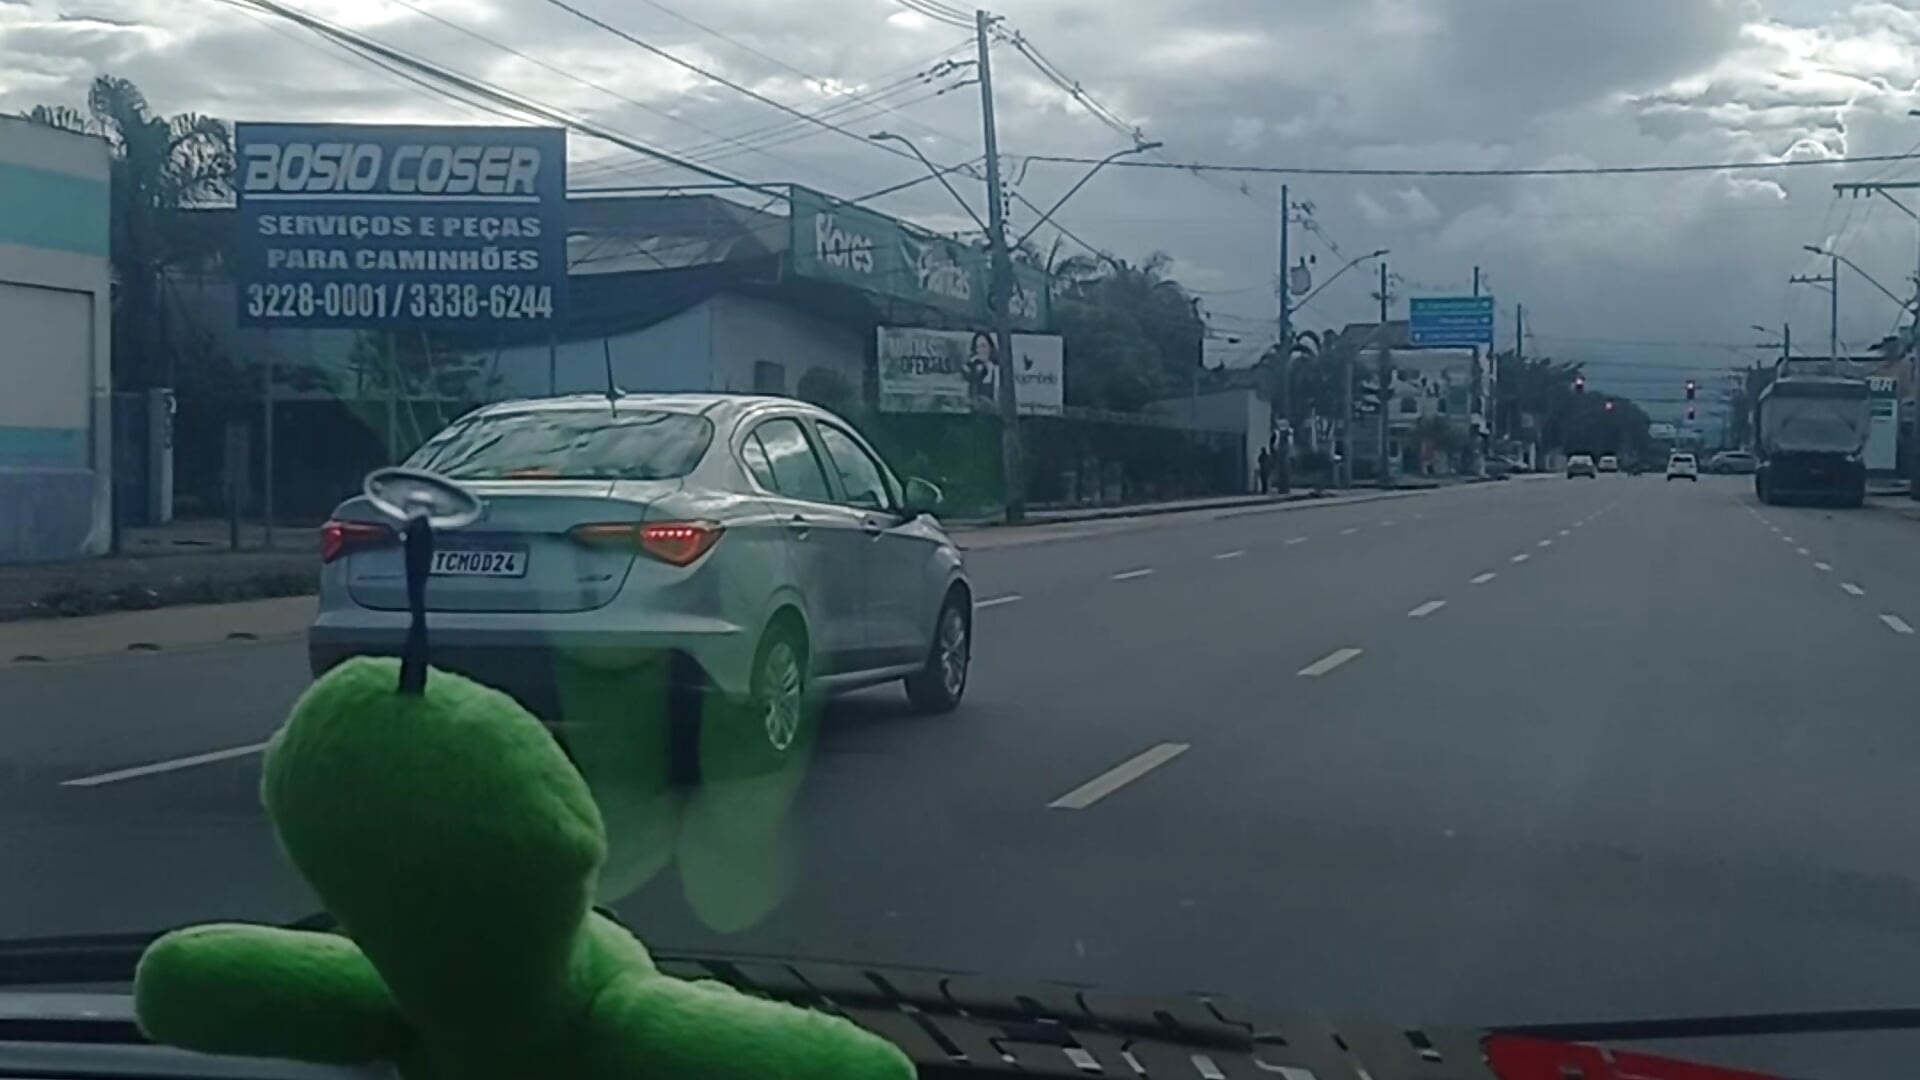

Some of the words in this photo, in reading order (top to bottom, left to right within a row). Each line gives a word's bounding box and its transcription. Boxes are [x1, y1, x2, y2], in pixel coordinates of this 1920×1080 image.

[243, 143, 382, 191] BOSIO
[388, 144, 541, 194] COSER
[258, 215, 412, 240] SERVIÇOS
[420, 217, 436, 237] E
[443, 216, 541, 241] PEÇAS
[267, 248, 348, 270] PARA
[355, 246, 539, 271] CAMINHÕES
[248, 282, 387, 318] 3228-0001
[392, 282, 404, 317] /
[410, 284, 553, 319] 3338-6244
